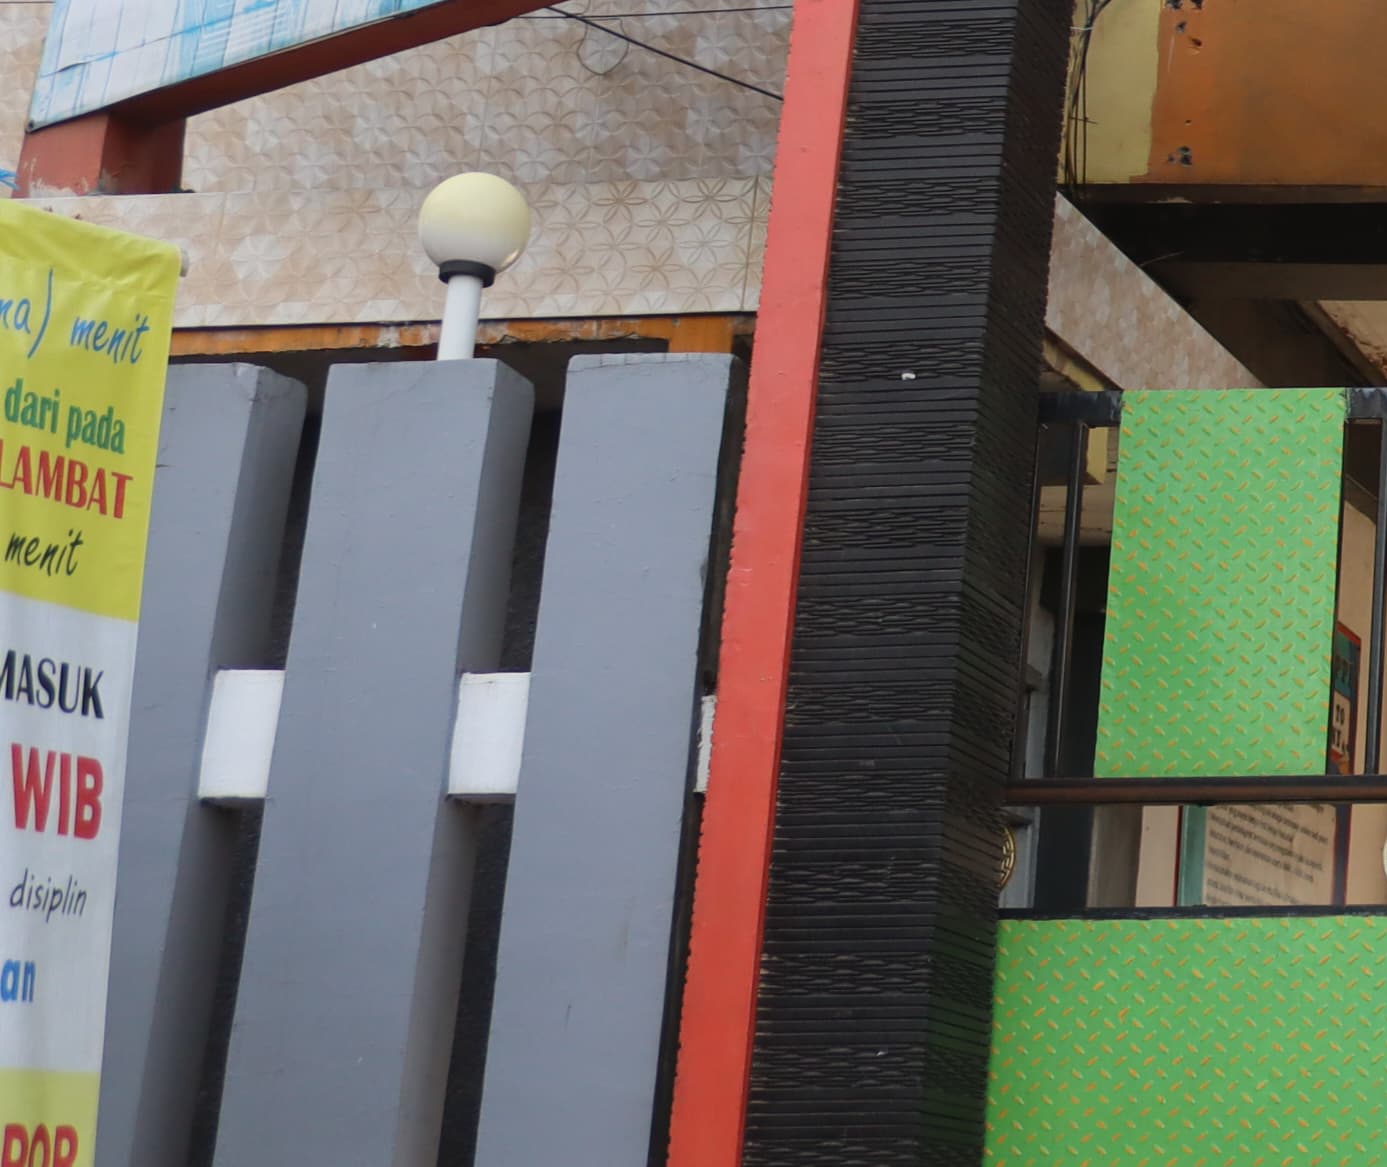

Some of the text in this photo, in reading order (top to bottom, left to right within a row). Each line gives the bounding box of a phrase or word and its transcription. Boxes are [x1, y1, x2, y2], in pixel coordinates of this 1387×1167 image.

[70, 314, 150, 365] menit
[5, 378, 125, 454] dari pada
[5, 528, 84, 577] menit
[11, 743, 103, 839] WIB
[9, 868, 87, 923] disiplin
